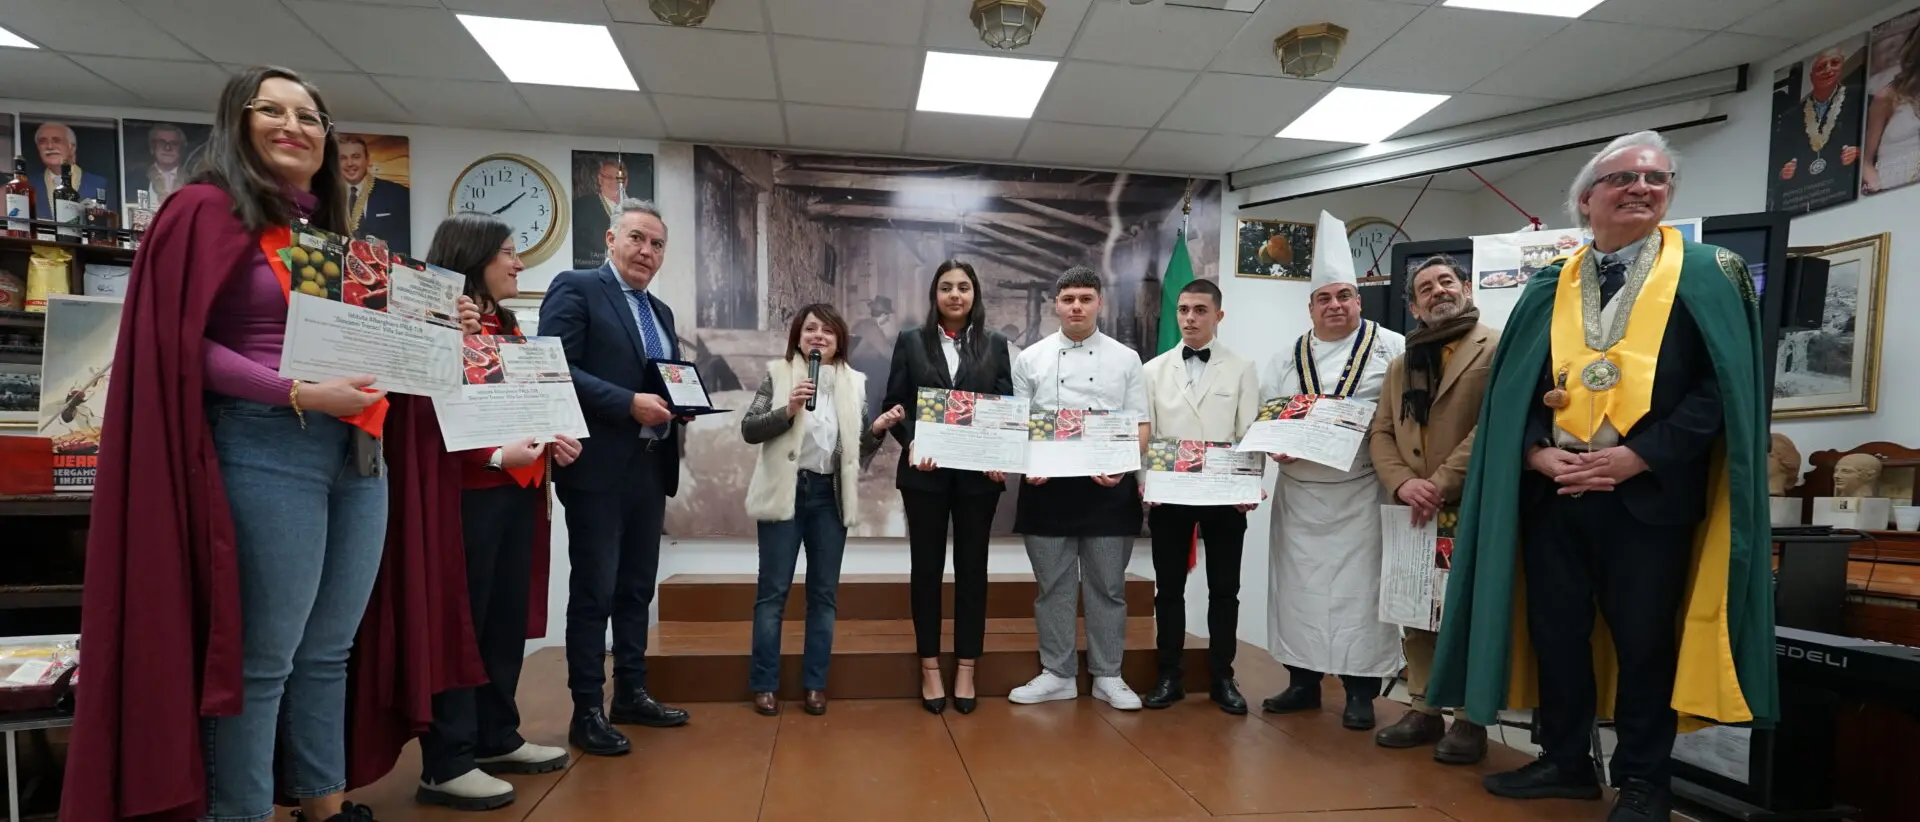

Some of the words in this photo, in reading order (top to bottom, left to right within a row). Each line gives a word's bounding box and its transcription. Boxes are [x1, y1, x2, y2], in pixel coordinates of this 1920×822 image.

[483, 175, 494, 187] 11
[498, 170, 512, 182] 12
[521, 175, 525, 187] 1
[472, 187, 485, 199] 10
[530, 187, 538, 199] 2
[465, 202, 475, 211] 9
[538, 205, 544, 216] 3
[531, 221, 539, 231] 4
[521, 232, 528, 243] 5
[1360, 236, 1368, 247] 11
[1372, 232, 1383, 243] 12
